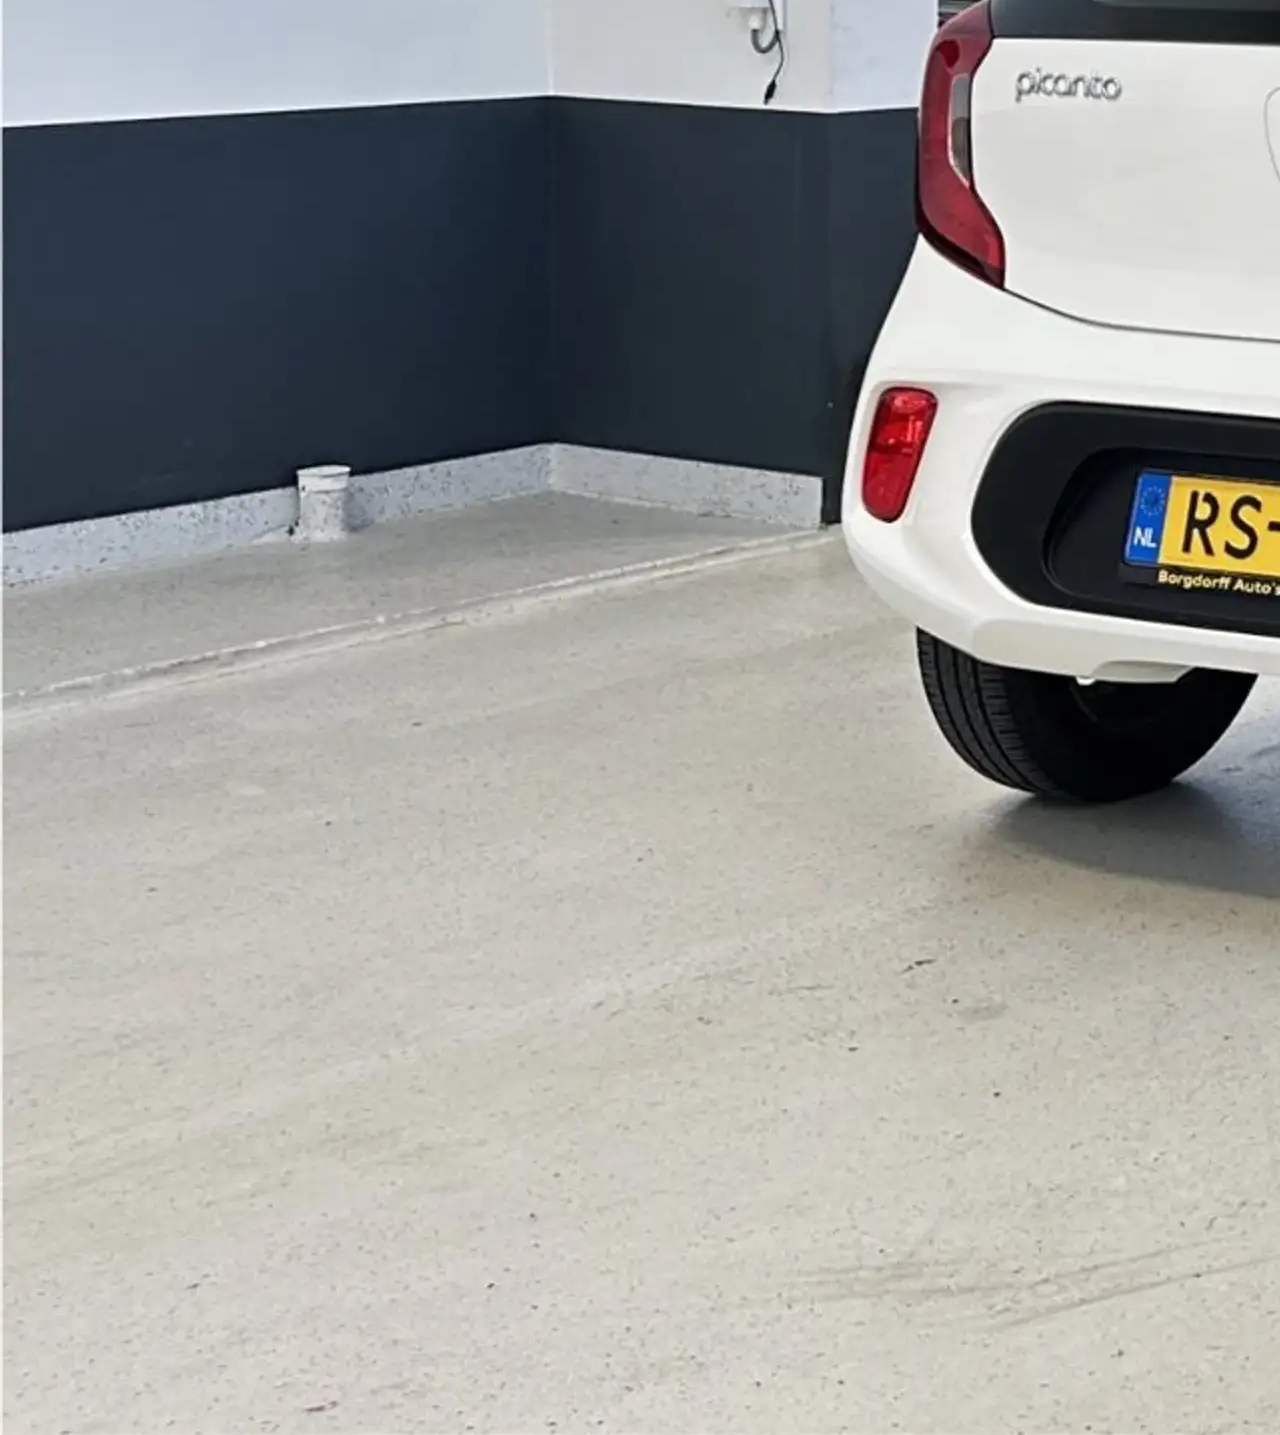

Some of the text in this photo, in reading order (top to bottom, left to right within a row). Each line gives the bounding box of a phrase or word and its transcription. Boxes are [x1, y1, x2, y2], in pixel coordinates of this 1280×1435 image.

[1015, 66, 1122, 103] picanto
[1133, 526, 1157, 548] NL
[1157, 569, 1231, 590] Borgdorff
